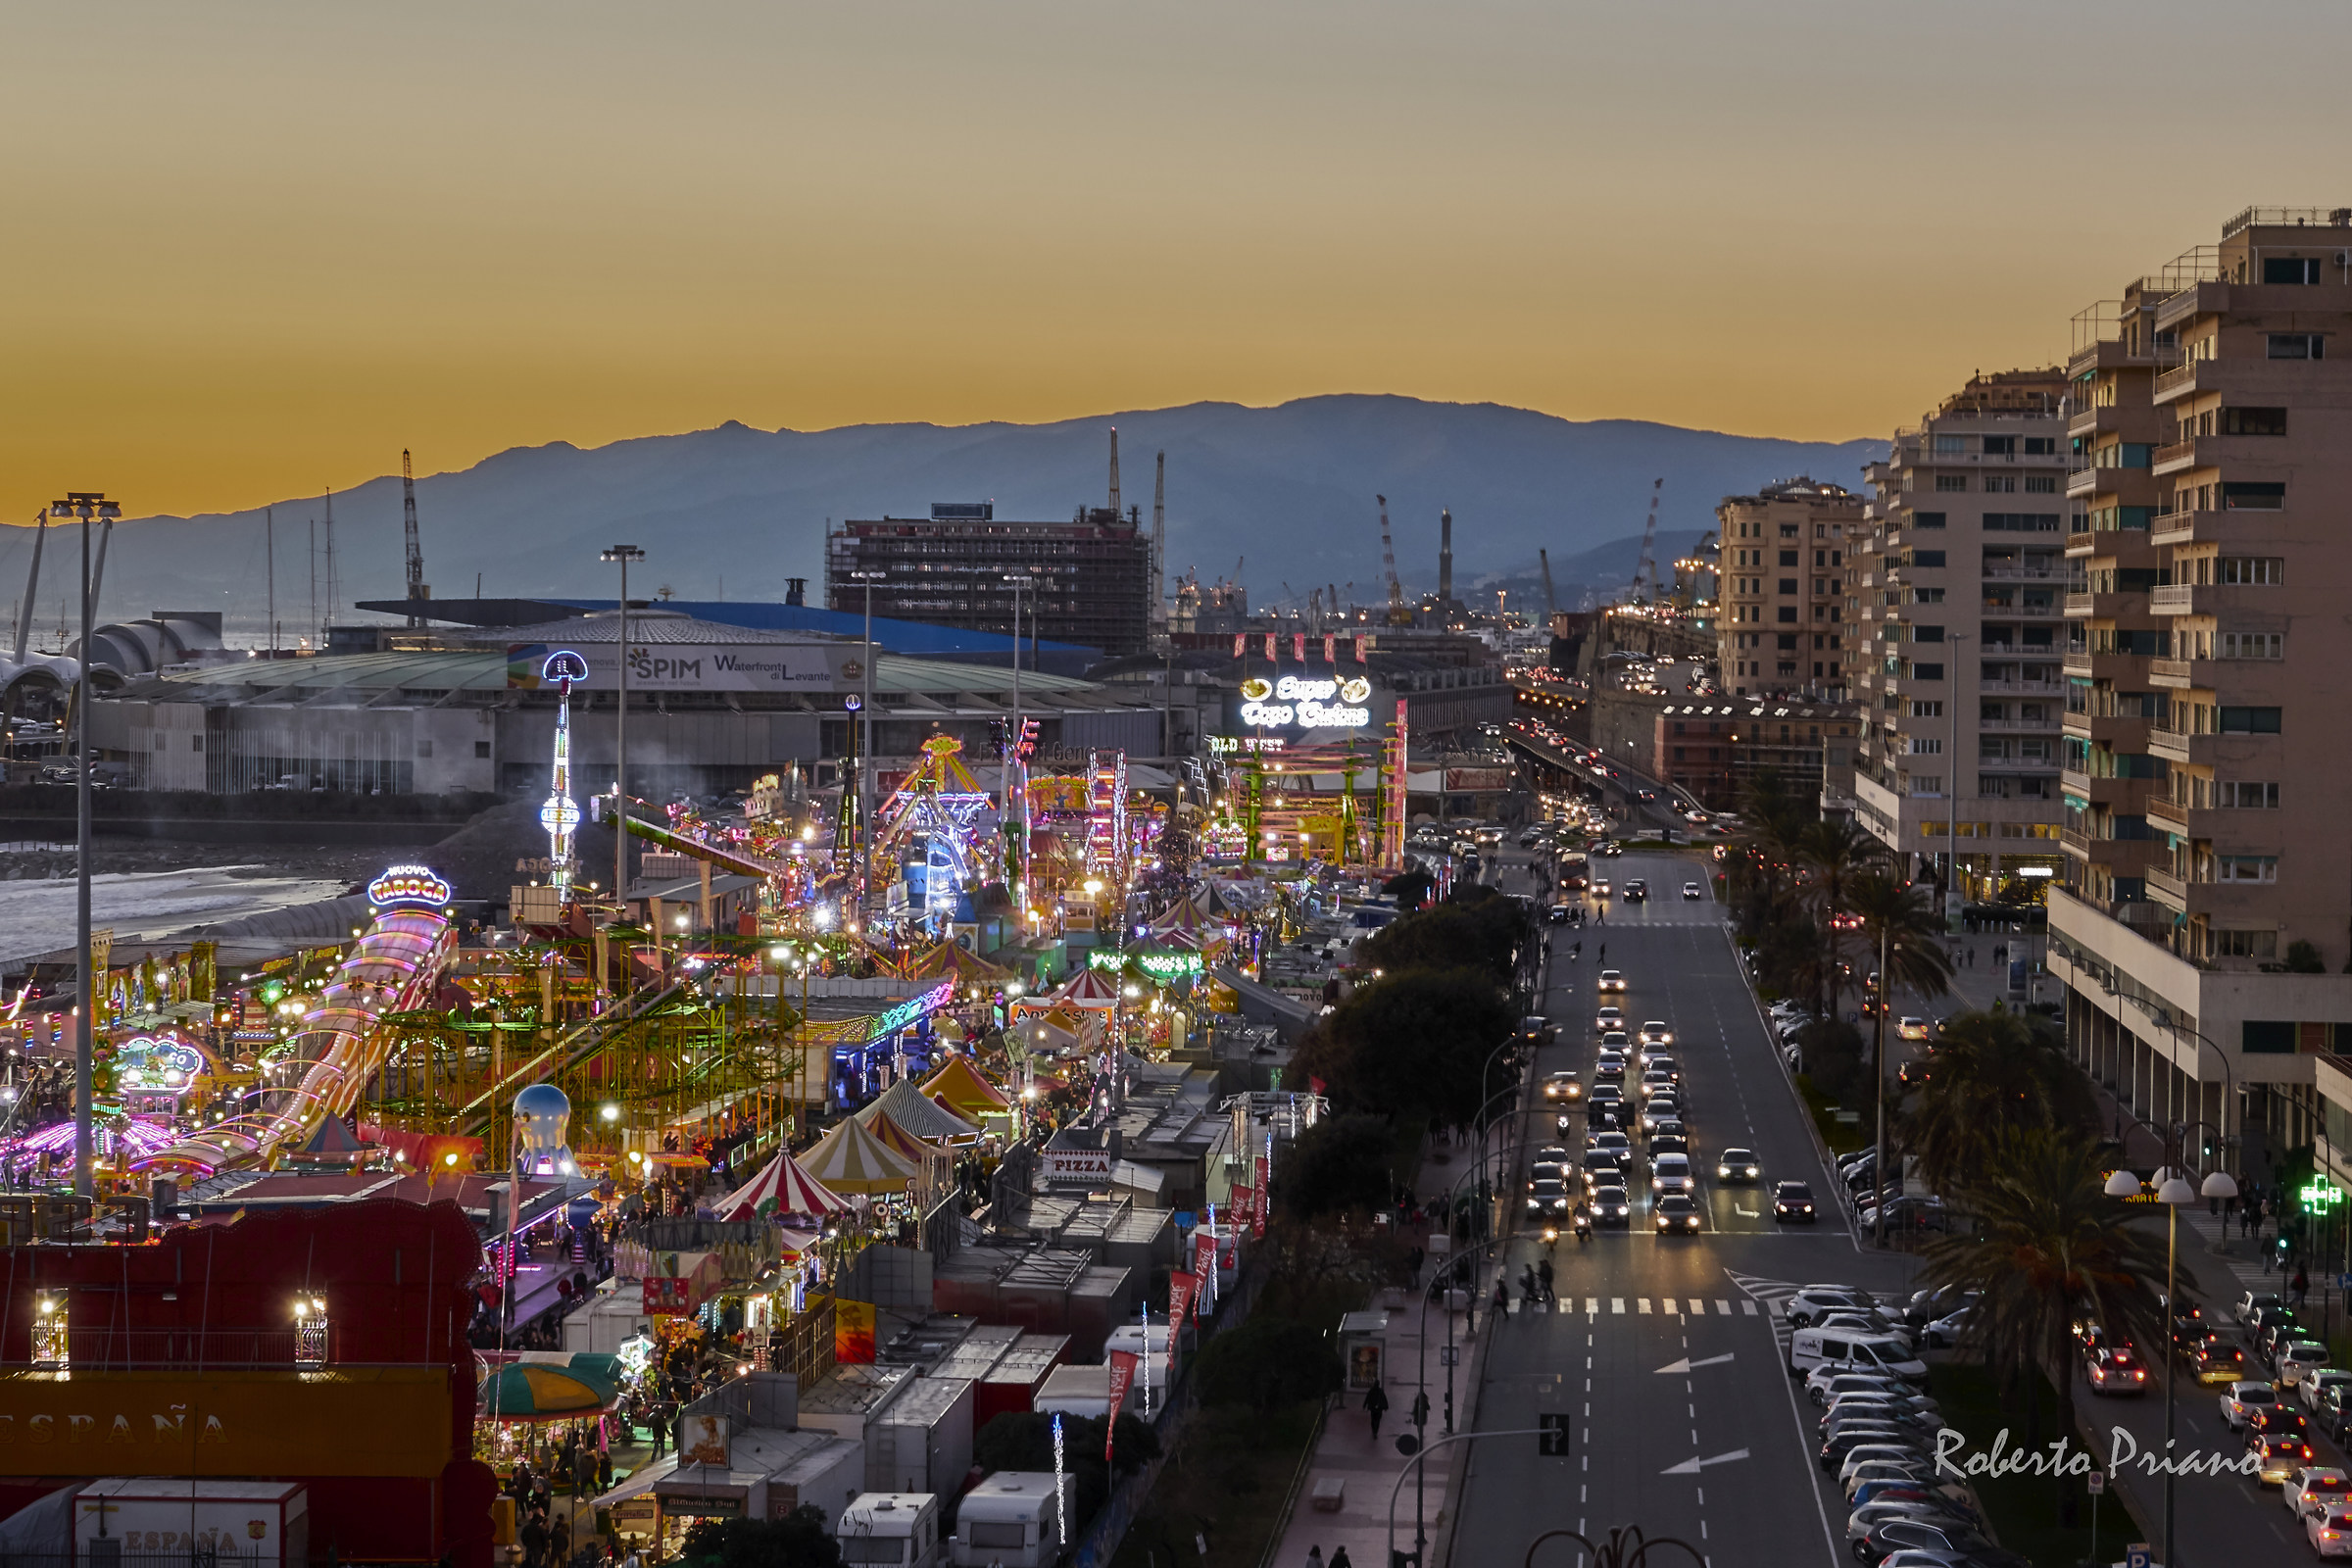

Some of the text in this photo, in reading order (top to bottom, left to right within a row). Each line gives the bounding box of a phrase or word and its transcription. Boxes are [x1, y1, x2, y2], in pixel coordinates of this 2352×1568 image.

[636, 659, 701, 679] SPIM
[713, 655, 782, 671] Waterfront
[782, 664, 831, 681] Levante
[1277, 675, 1336, 703] Super
[1211, 737, 1238, 752] OLD
[388, 864, 429, 877] NUOVO
[372, 879, 446, 902] TABOCA
[1054, 1159, 1108, 1172] PIZZA
[1196, 1248, 1212, 1275] Park
[0, 1403, 230, 1445] ESPAÑA
[125, 1527, 238, 1552] ESPAÑA
[2132, 1554, 2145, 1568] P
